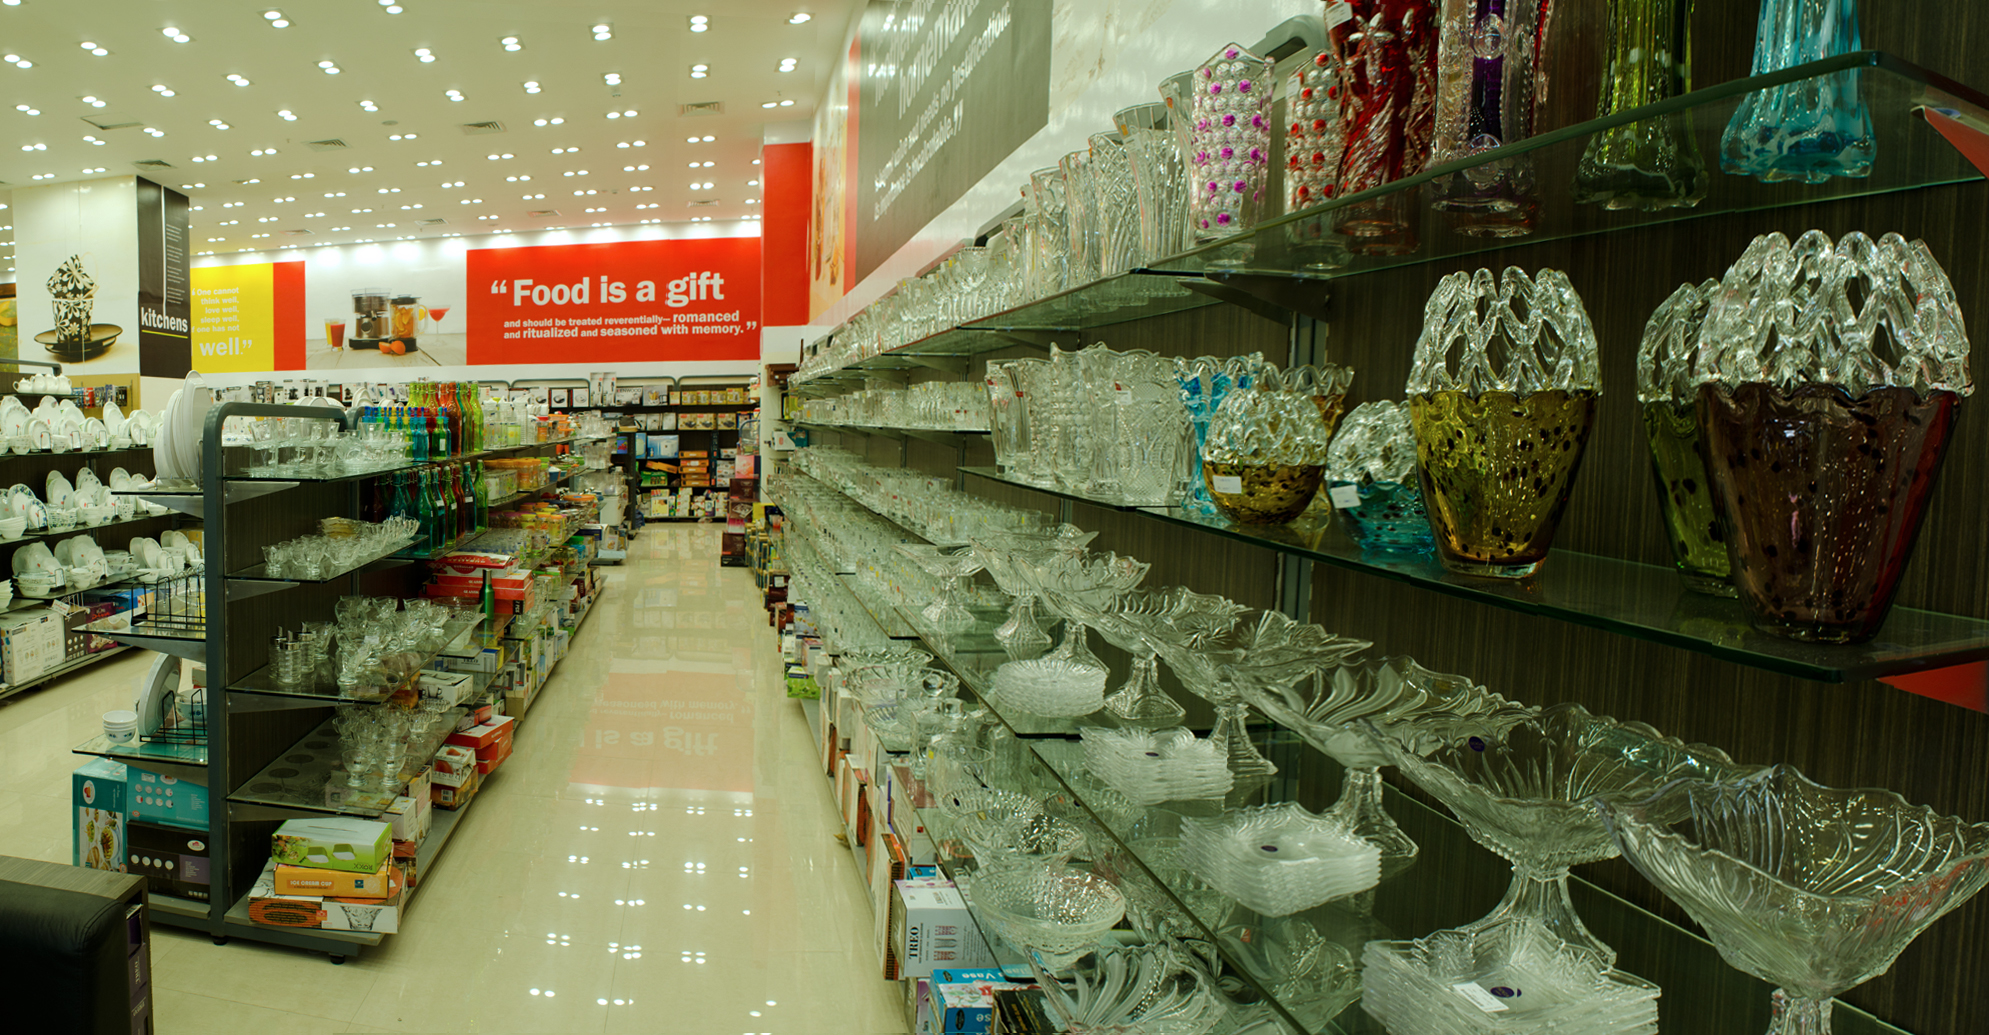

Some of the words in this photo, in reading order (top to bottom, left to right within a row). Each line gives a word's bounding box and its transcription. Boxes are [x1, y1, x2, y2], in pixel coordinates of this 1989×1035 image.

[941, 79, 950, 109] no
[952, 1, 1011, 102] justification.
[213, 286, 239, 295] cannot
[600, 275, 627, 303] is
[635, 281, 655, 302] a
[665, 271, 725, 307] gift
[200, 297, 220, 305] think
[205, 306, 220, 314] love
[140, 306, 188, 333] kitchens
[200, 316, 220, 324] sleep
[503, 318, 521, 328] and
[522, 317, 553, 328] should
[555, 316, 566, 327] be
[568, 316, 602, 327] treated
[673, 310, 740, 323] romanced
[227, 324, 240, 332] not
[503, 329, 521, 339] and
[522, 325, 578, 339] ritualized
[580, 327, 598, 337] and
[600, 324, 658, 337] seasoned
[661, 323, 689, 335] with
[909, 926, 919, 960] TREO
[961, 972, 996, 981] Vase
